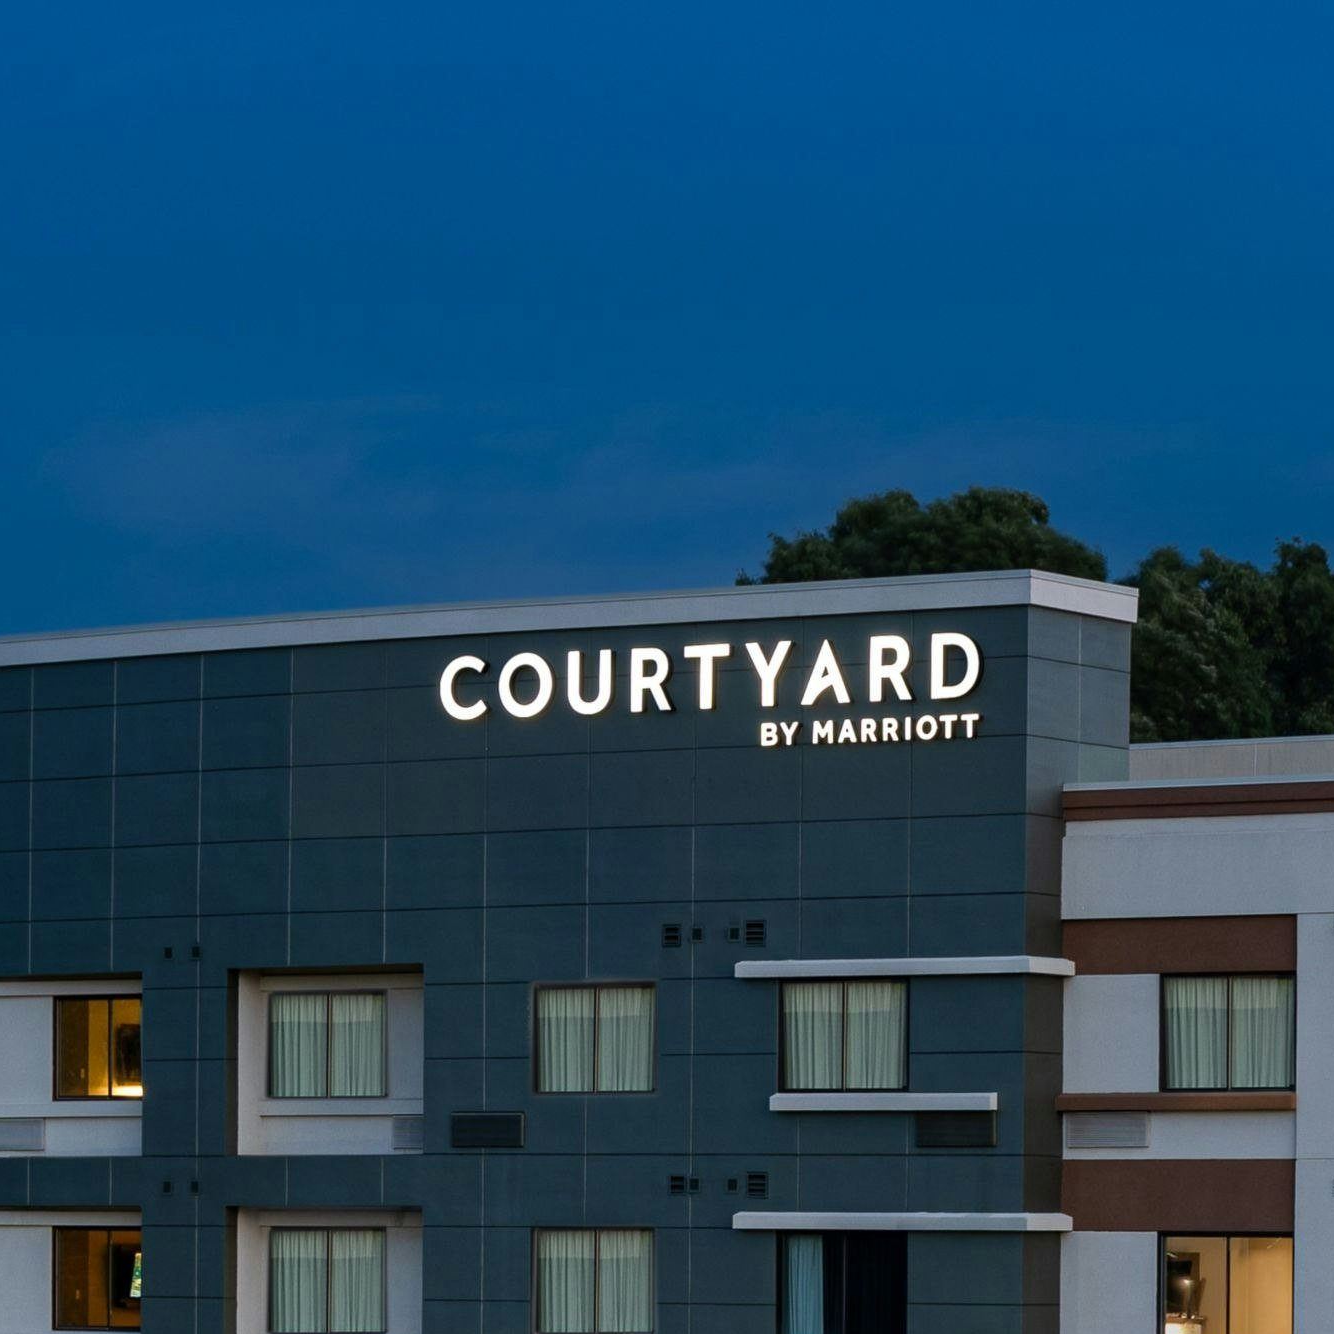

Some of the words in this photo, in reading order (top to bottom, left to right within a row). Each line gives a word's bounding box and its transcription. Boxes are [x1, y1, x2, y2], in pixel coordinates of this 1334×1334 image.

[439, 632, 980, 720] COURTYARD
[760, 721, 799, 747] BY
[812, 713, 980, 744] MARRIOTT
